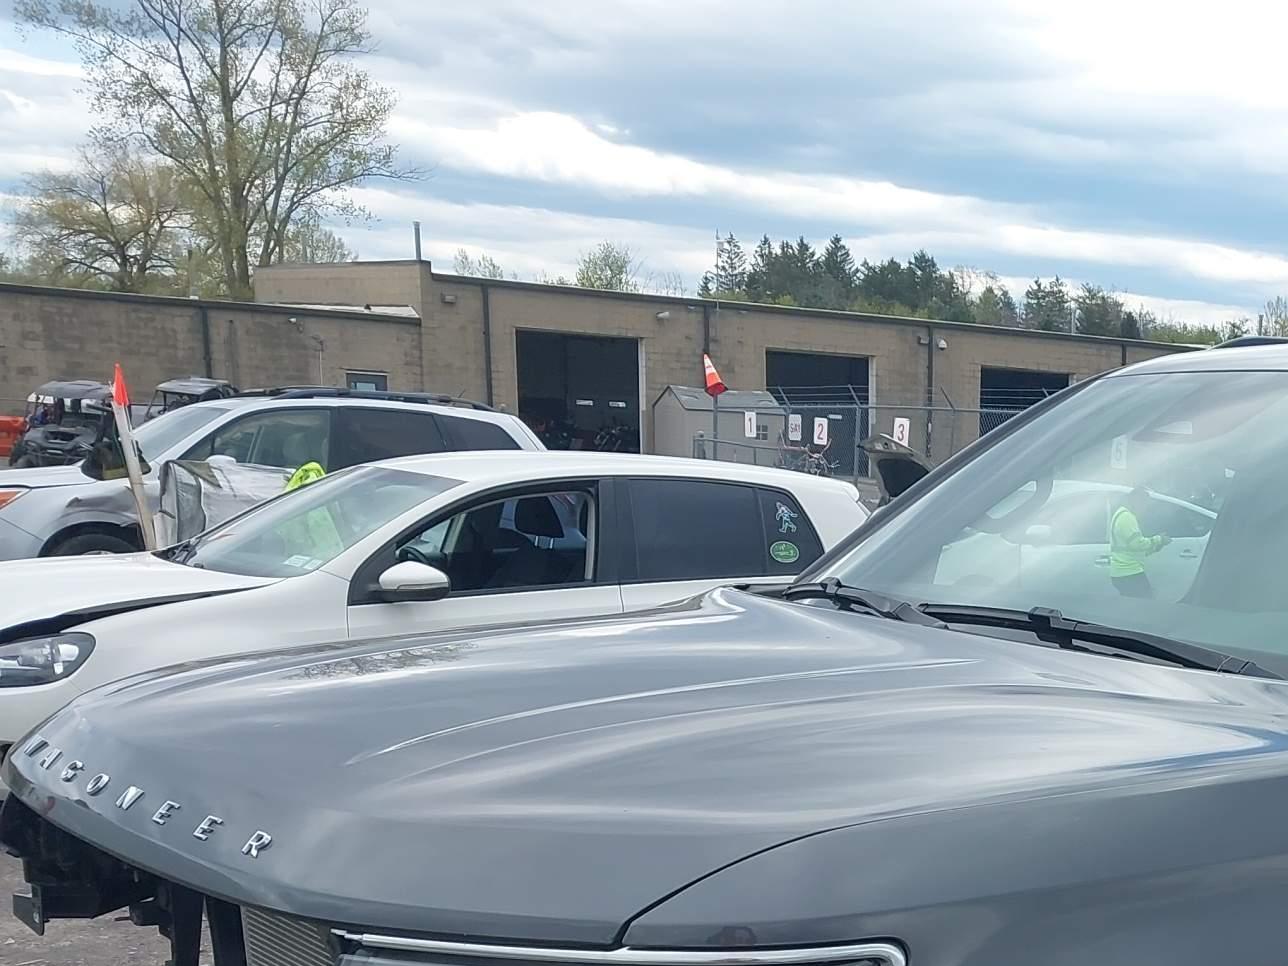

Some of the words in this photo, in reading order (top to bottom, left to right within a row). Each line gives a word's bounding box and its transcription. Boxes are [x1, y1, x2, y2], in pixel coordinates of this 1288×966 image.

[816, 423, 824, 440] 2
[897, 424, 905, 442] 3
[24, 735, 272, 858] WAGONEER
